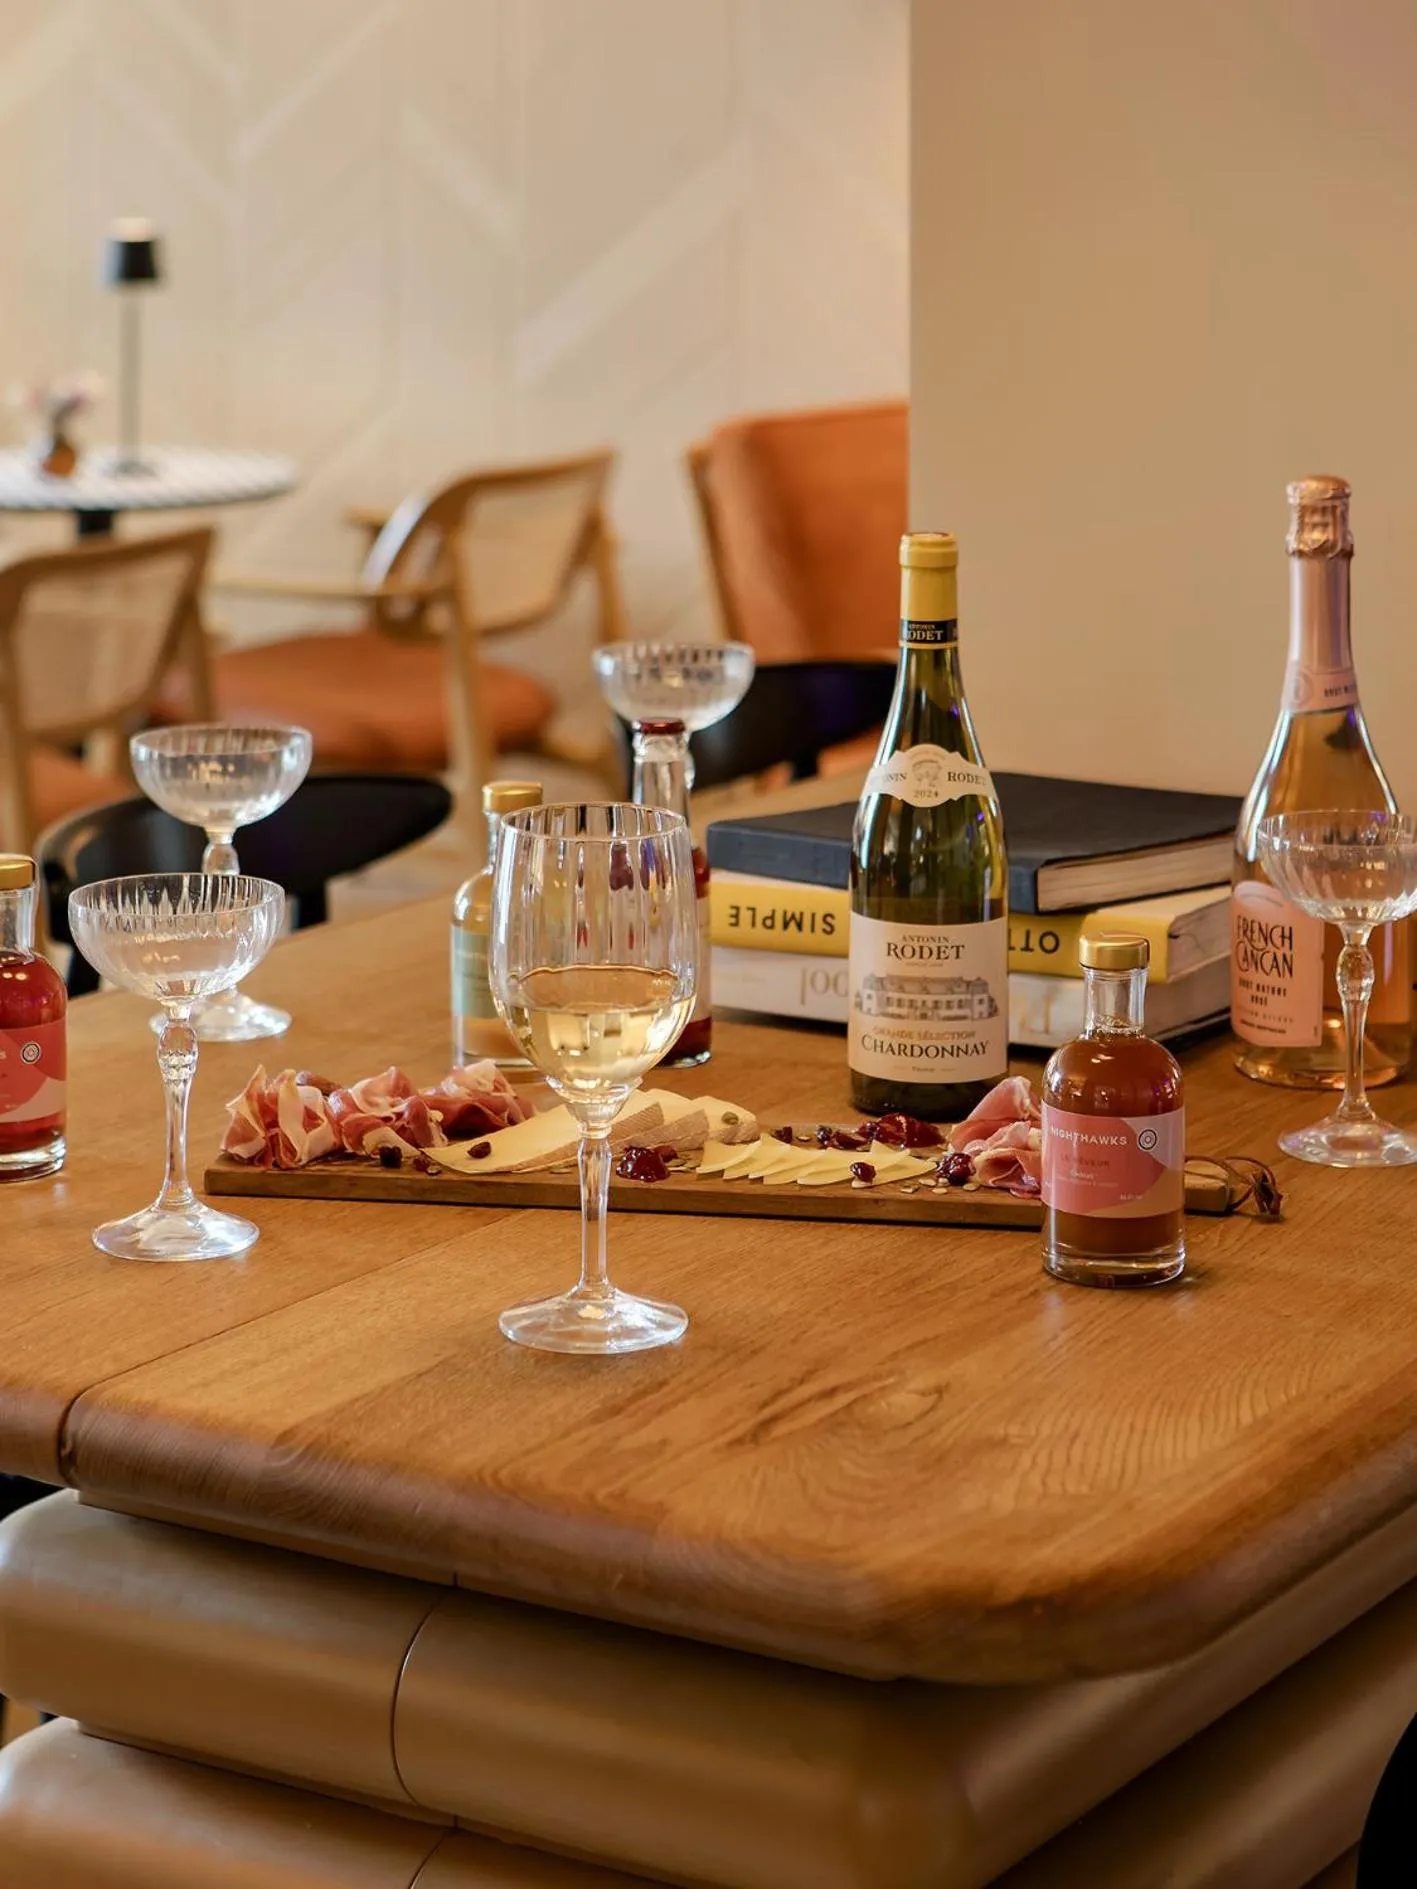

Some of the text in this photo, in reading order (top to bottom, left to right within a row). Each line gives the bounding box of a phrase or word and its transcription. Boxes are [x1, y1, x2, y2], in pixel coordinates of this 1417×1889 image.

[728, 904, 837, 936] SIMPLE
[901, 934, 951, 944] ANTONIN
[1236, 915, 1294, 952] FRENCH
[886, 942, 966, 961] RODET
[1235, 940, 1294, 980] CANCAN
[1050, 1125, 1129, 1146] NIGHTHAWKS
